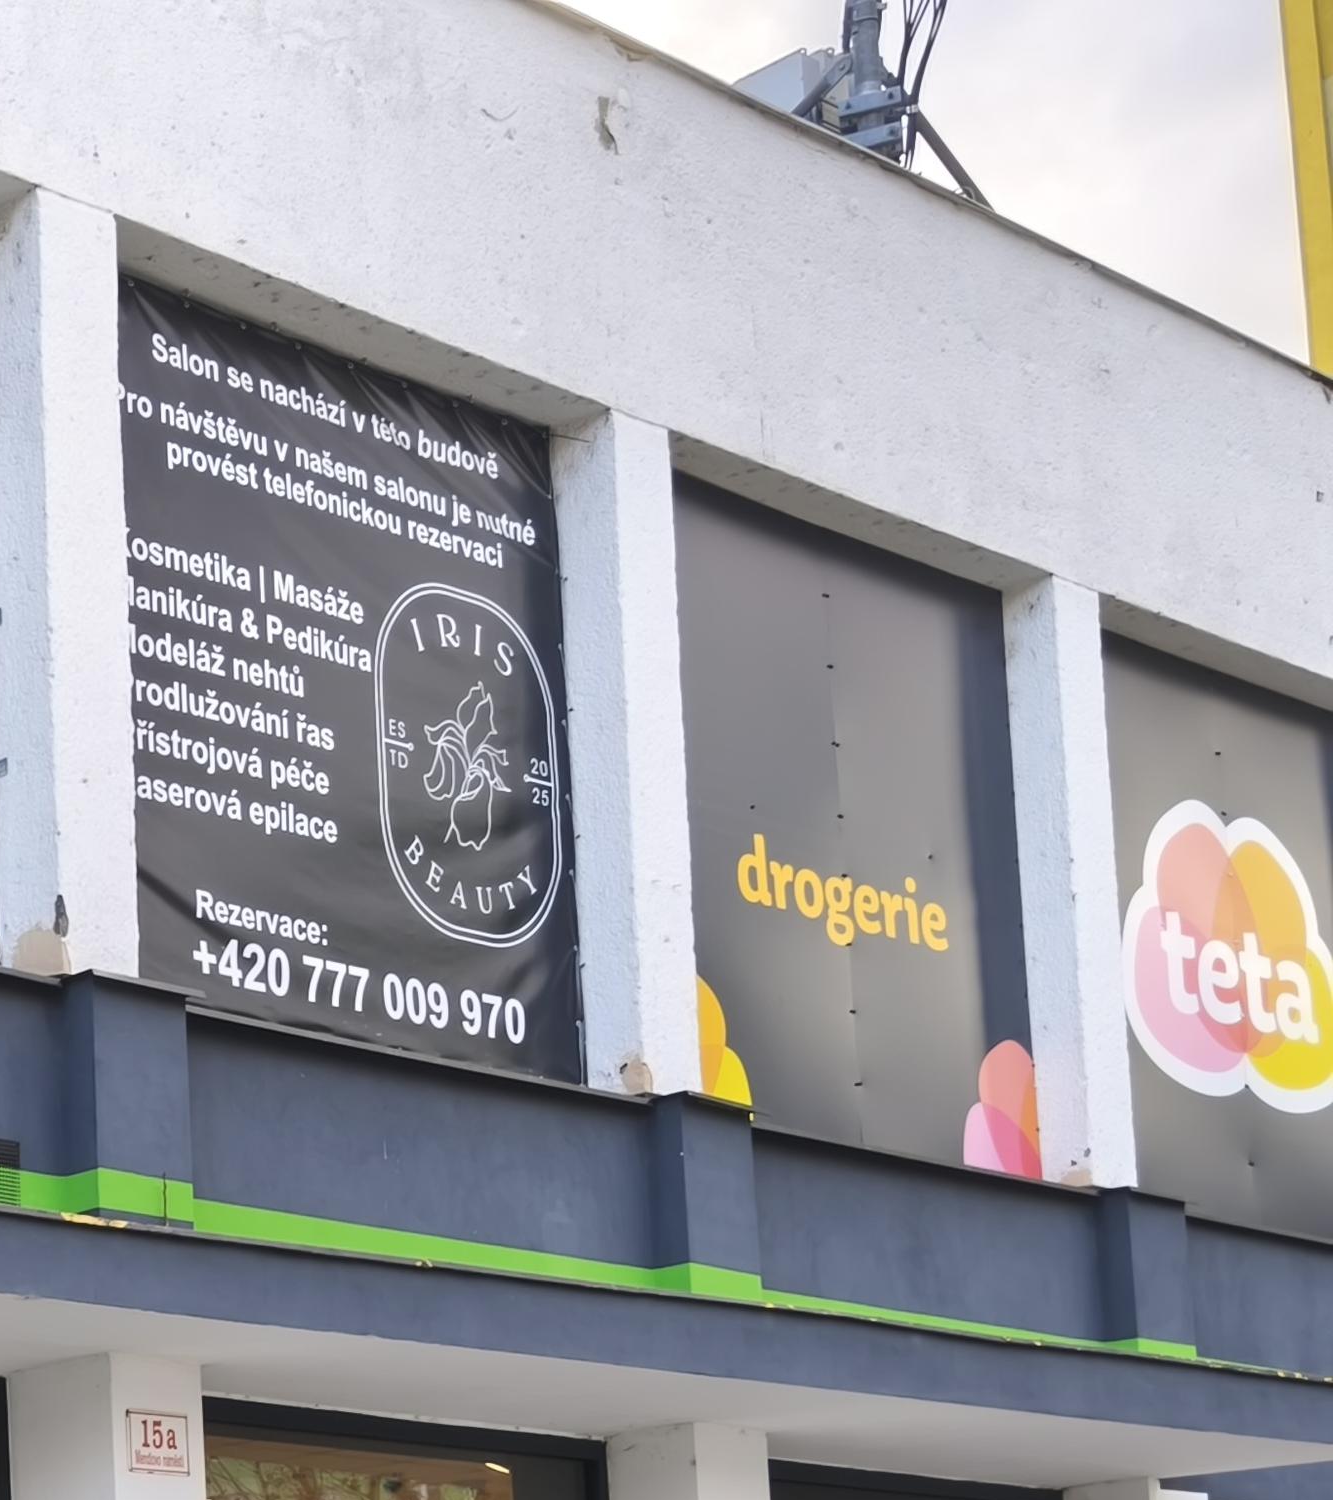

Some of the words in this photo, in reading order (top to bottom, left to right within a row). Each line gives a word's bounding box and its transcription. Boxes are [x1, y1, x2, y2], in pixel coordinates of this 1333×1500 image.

[152, 334, 220, 381] Salon
[227, 367, 254, 393] se
[260, 369, 347, 428] nachází
[351, 410, 366, 433] v
[371, 414, 412, 450] této
[417, 429, 500, 479] budově
[160, 401, 268, 457] návštěvu
[274, 438, 290, 461] v
[296, 449, 368, 490] našem
[374, 474, 446, 516] salonu
[452, 493, 471, 526] je
[477, 509, 536, 547] nutné
[167, 441, 259, 490] provést
[263, 467, 401, 536] telefonickou
[407, 517, 504, 569] rezervaci
[273, 571, 365, 624] Masáže
[233, 655, 306, 698] nehtů
[240, 608, 259, 640] &
[266, 615, 373, 673] Pedikúra
[410, 612, 514, 677] IRIS
[135, 677, 290, 741] rodlužování
[296, 712, 335, 752] řas
[136, 718, 263, 781] řístrojová
[270, 757, 331, 798] péče
[530, 757, 550, 779] 20
[136, 774, 244, 821] aserová
[249, 797, 339, 845] epilace
[532, 787, 550, 808] 25
[404, 835, 538, 915] BEAUTY
[737, 833, 949, 952] drogerie
[195, 888, 330, 946] Rezervace:
[192, 938, 291, 997] +420
[303, 955, 371, 1013] 777
[383, 973, 450, 1031] 009
[460, 990, 526, 1045] 970
[1159, 910, 1319, 1045] teta
[141, 1419, 177, 1450] 15a
